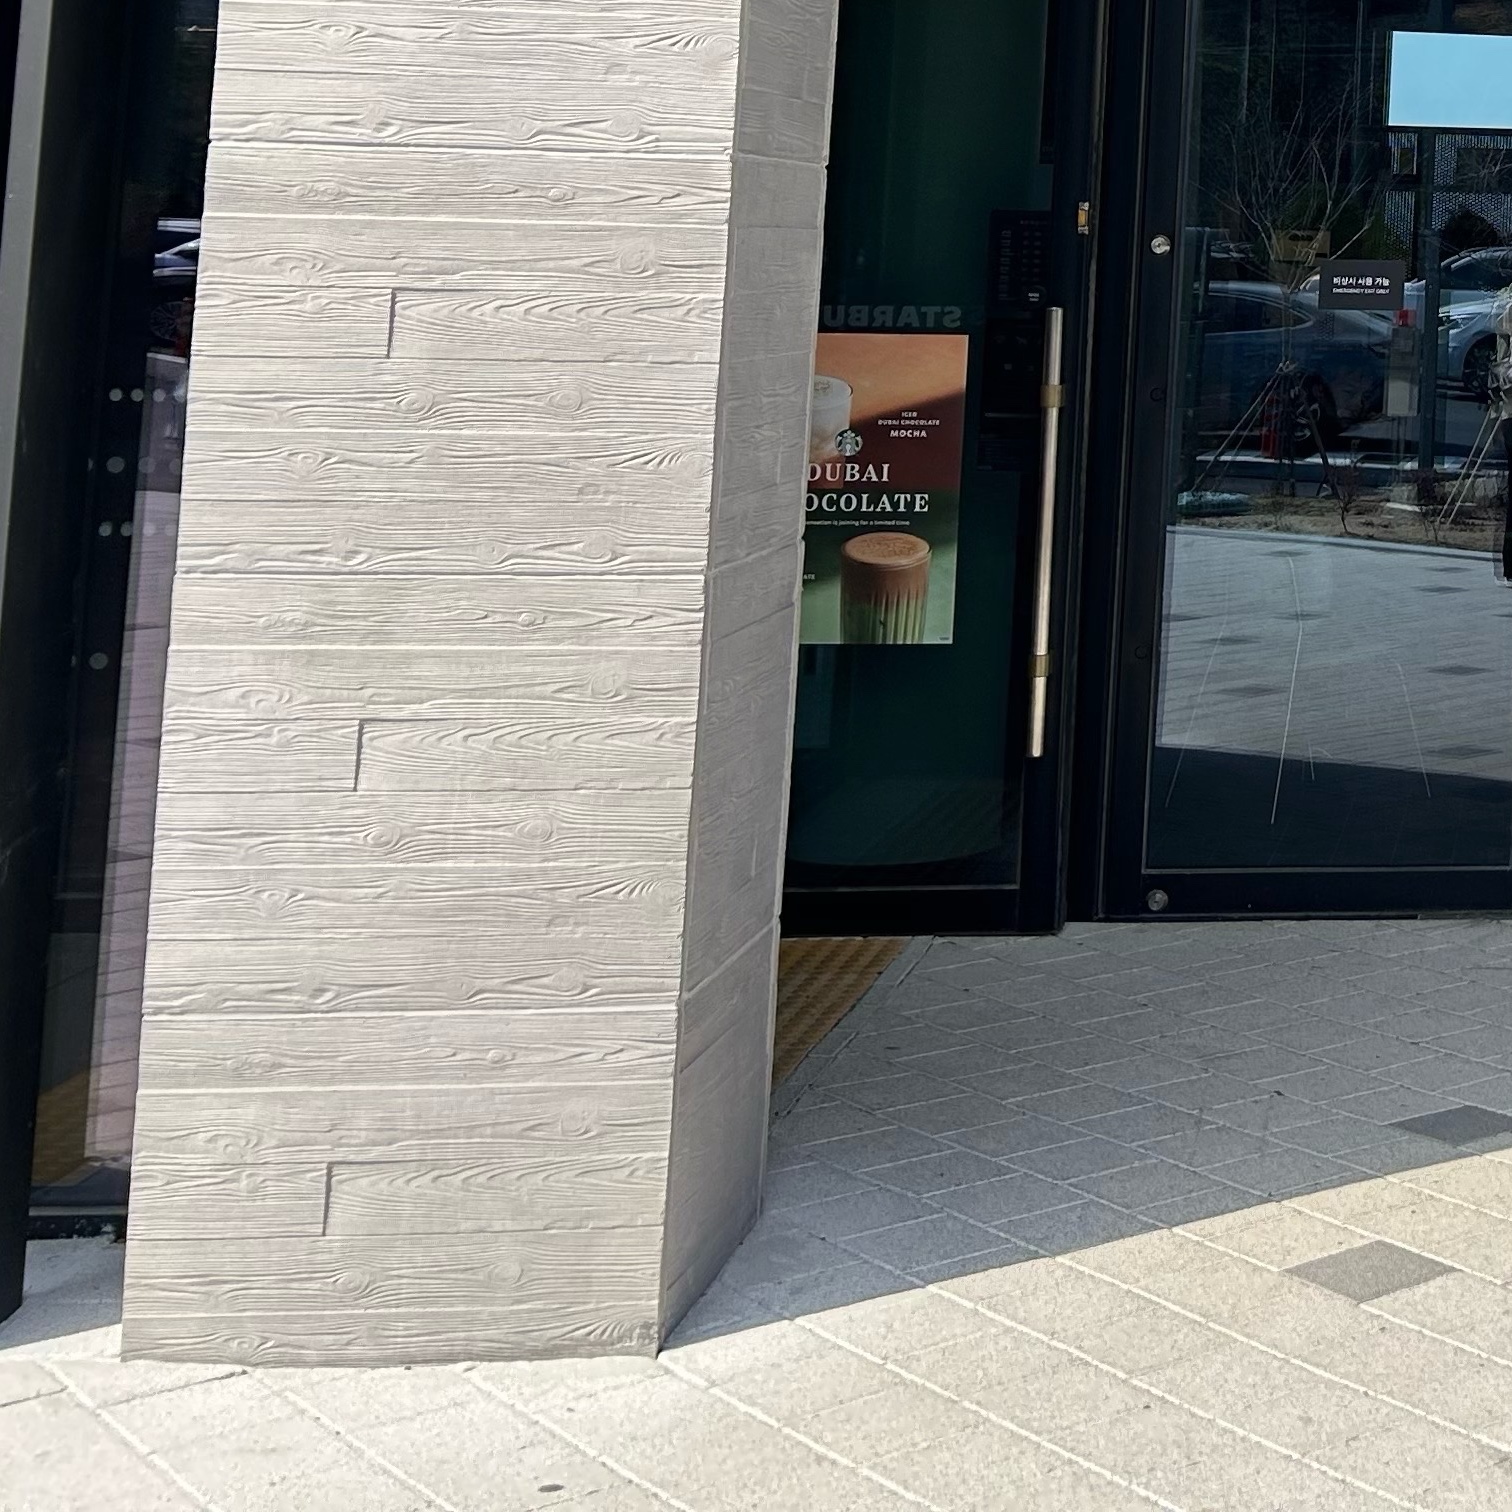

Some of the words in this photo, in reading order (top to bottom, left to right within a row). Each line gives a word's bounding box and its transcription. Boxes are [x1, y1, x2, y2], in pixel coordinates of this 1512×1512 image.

[1333, 276, 1357, 287] 비상시
[1357, 276, 1373, 286] 사용
[1374, 277, 1390, 287] 가능
[889, 429, 928, 438] MOCHA
[808, 463, 890, 482] DUBAI
